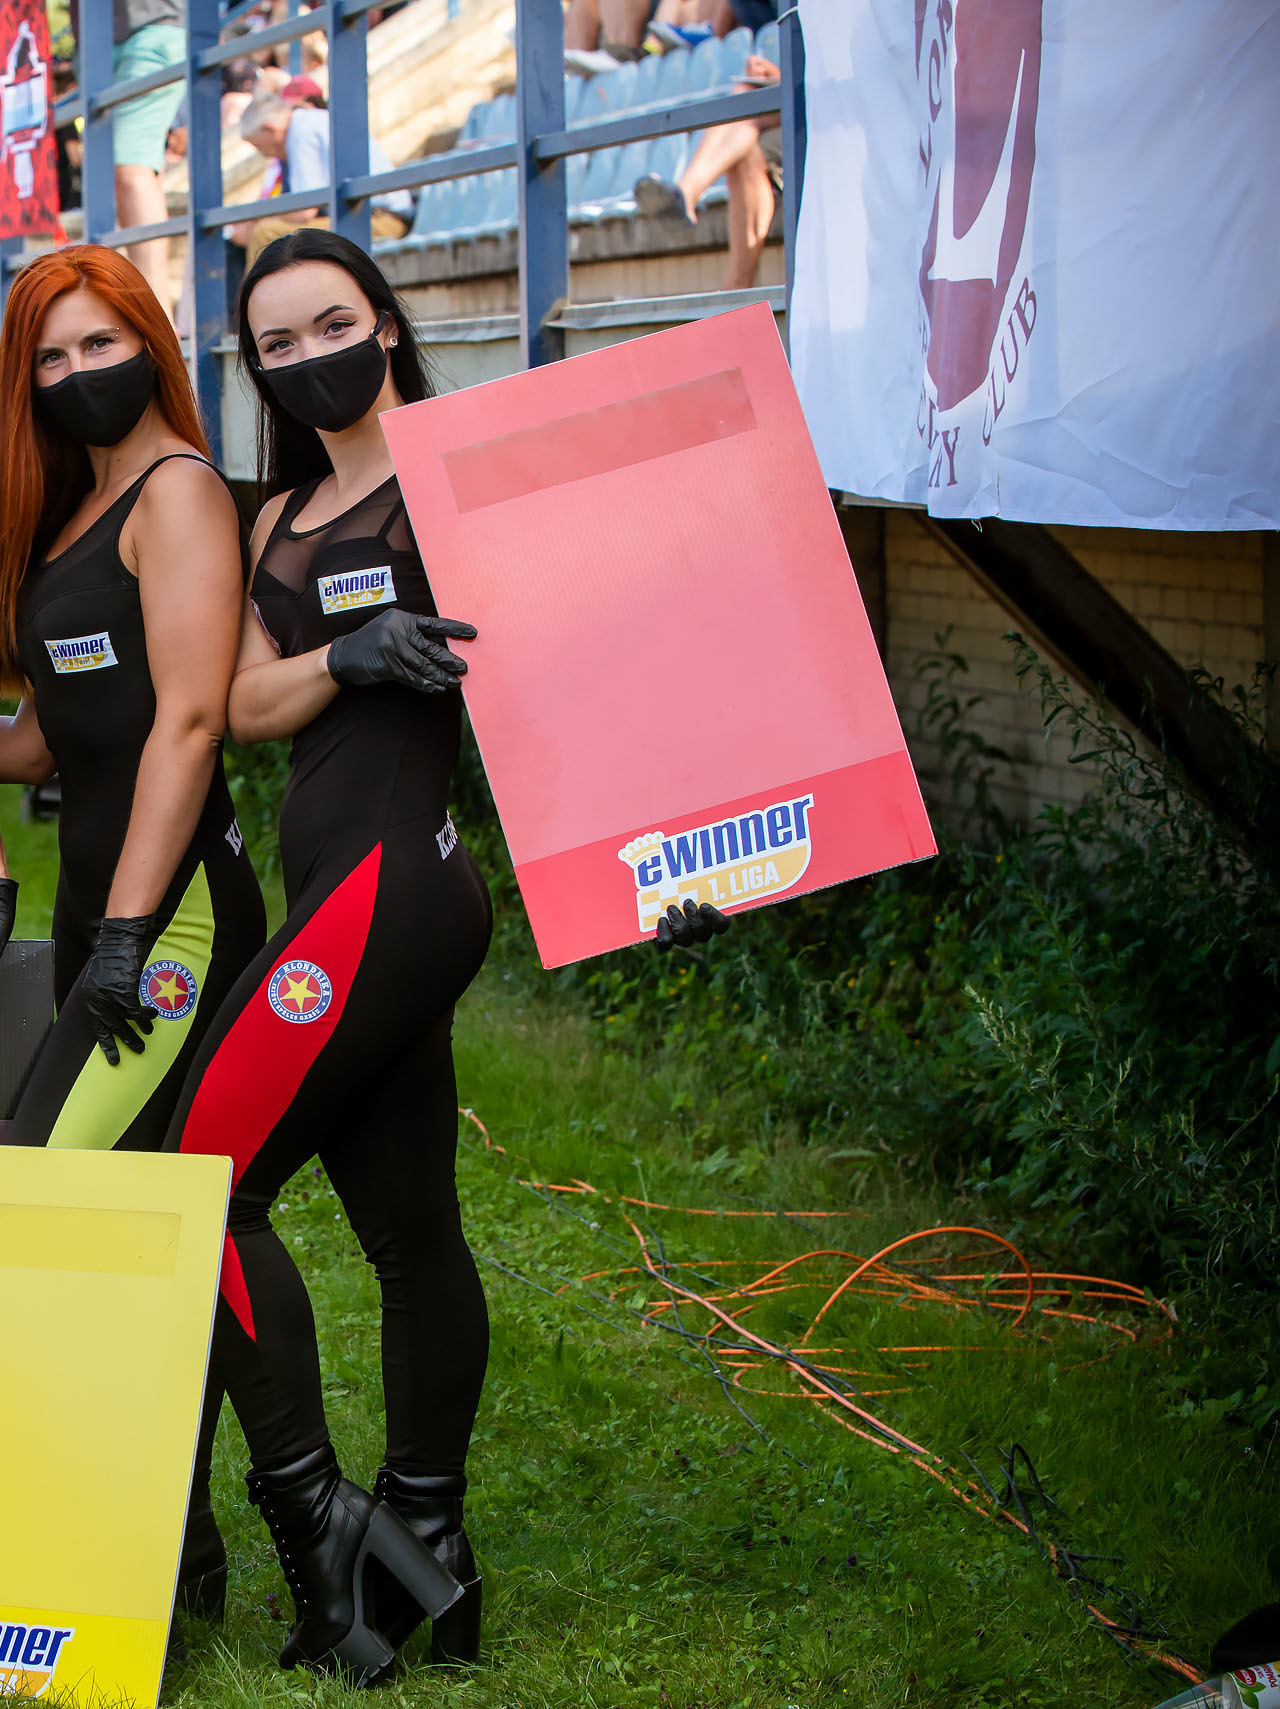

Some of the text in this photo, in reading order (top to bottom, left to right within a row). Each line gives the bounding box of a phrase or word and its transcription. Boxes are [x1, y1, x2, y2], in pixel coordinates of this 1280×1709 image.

[982, 277, 1037, 447] CLUB
[354, 592, 374, 604] LIGA
[707, 860, 781, 902] 1. LIGA
[148, 962, 196, 993] KLONDAIKA
[283, 962, 330, 996] KLONDAIKA
